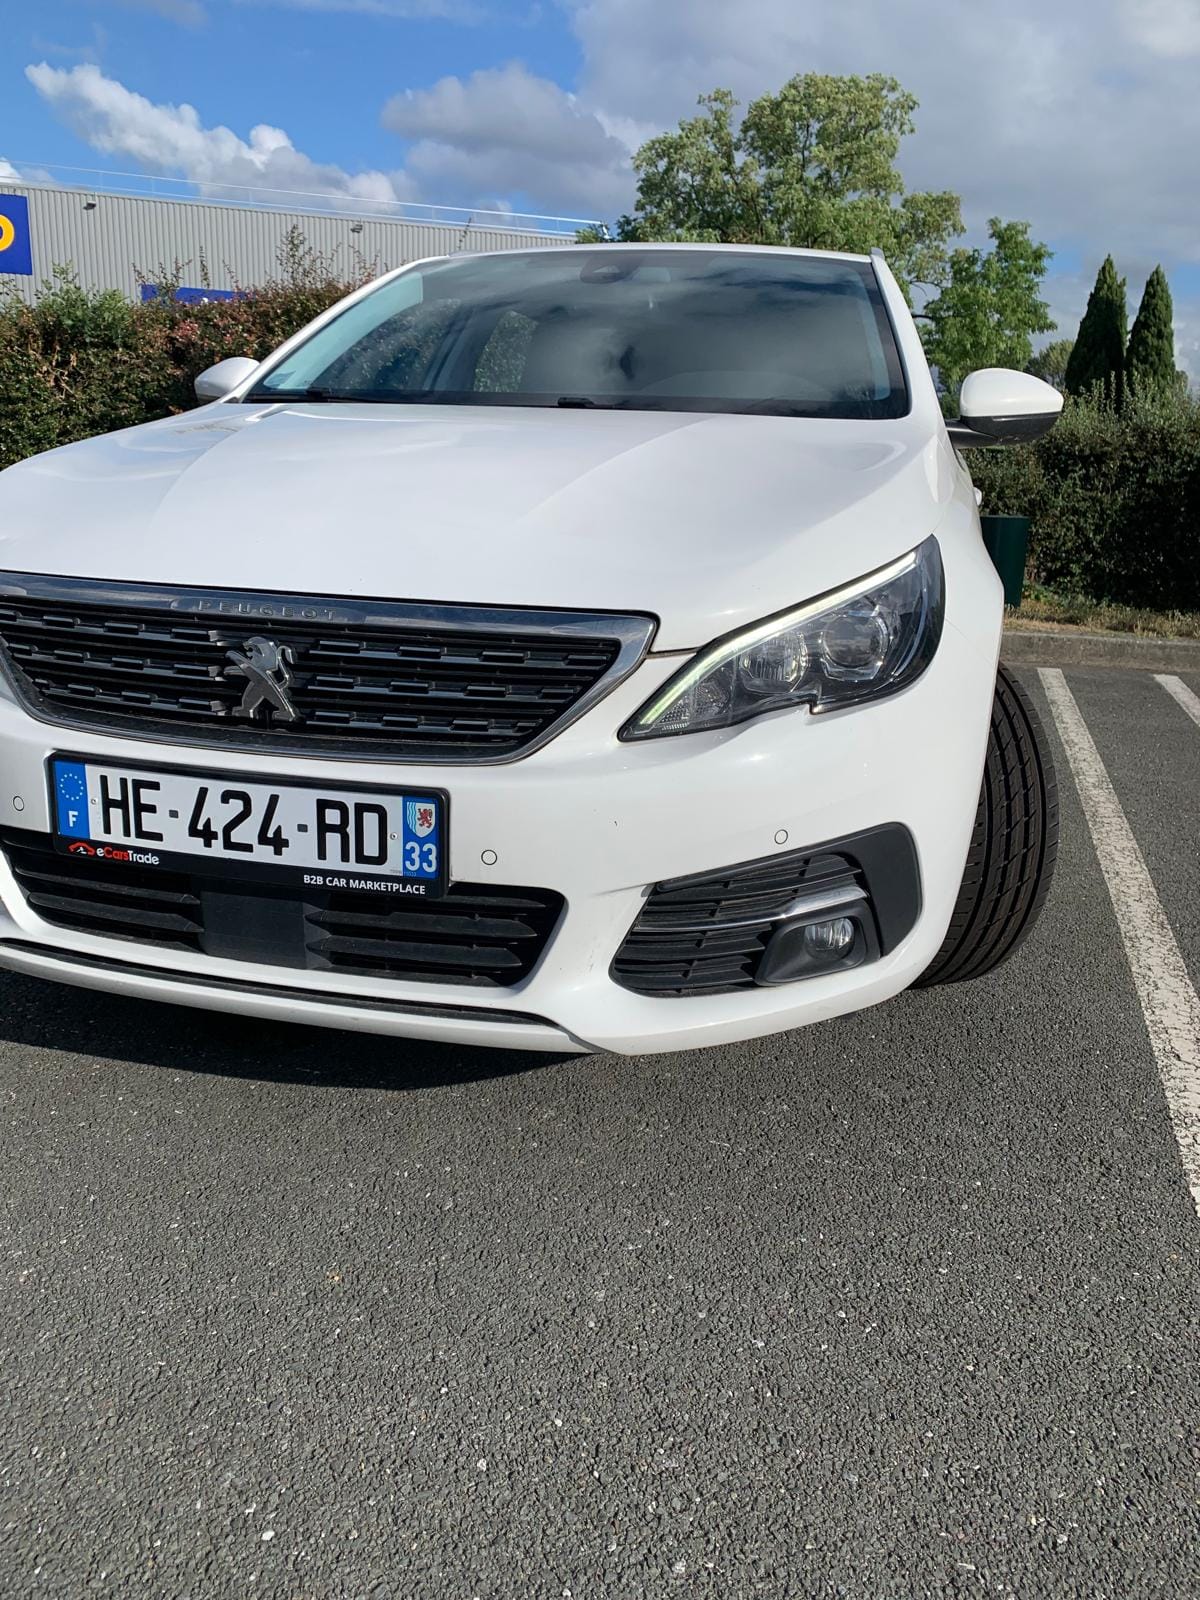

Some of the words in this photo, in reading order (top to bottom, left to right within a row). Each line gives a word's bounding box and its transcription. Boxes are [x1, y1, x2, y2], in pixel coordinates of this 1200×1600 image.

[199, 600, 337, 621] PEUGEOT
[68, 810, 79, 828] F
[99, 774, 388, 866] HE-424-RD
[96, 846, 160, 865] eCarsTrade
[404, 841, 437, 873] 33
[303, 874, 324, 885] B2B
[325, 877, 347, 888] CAR
[349, 879, 426, 895] MARKETPLACE
